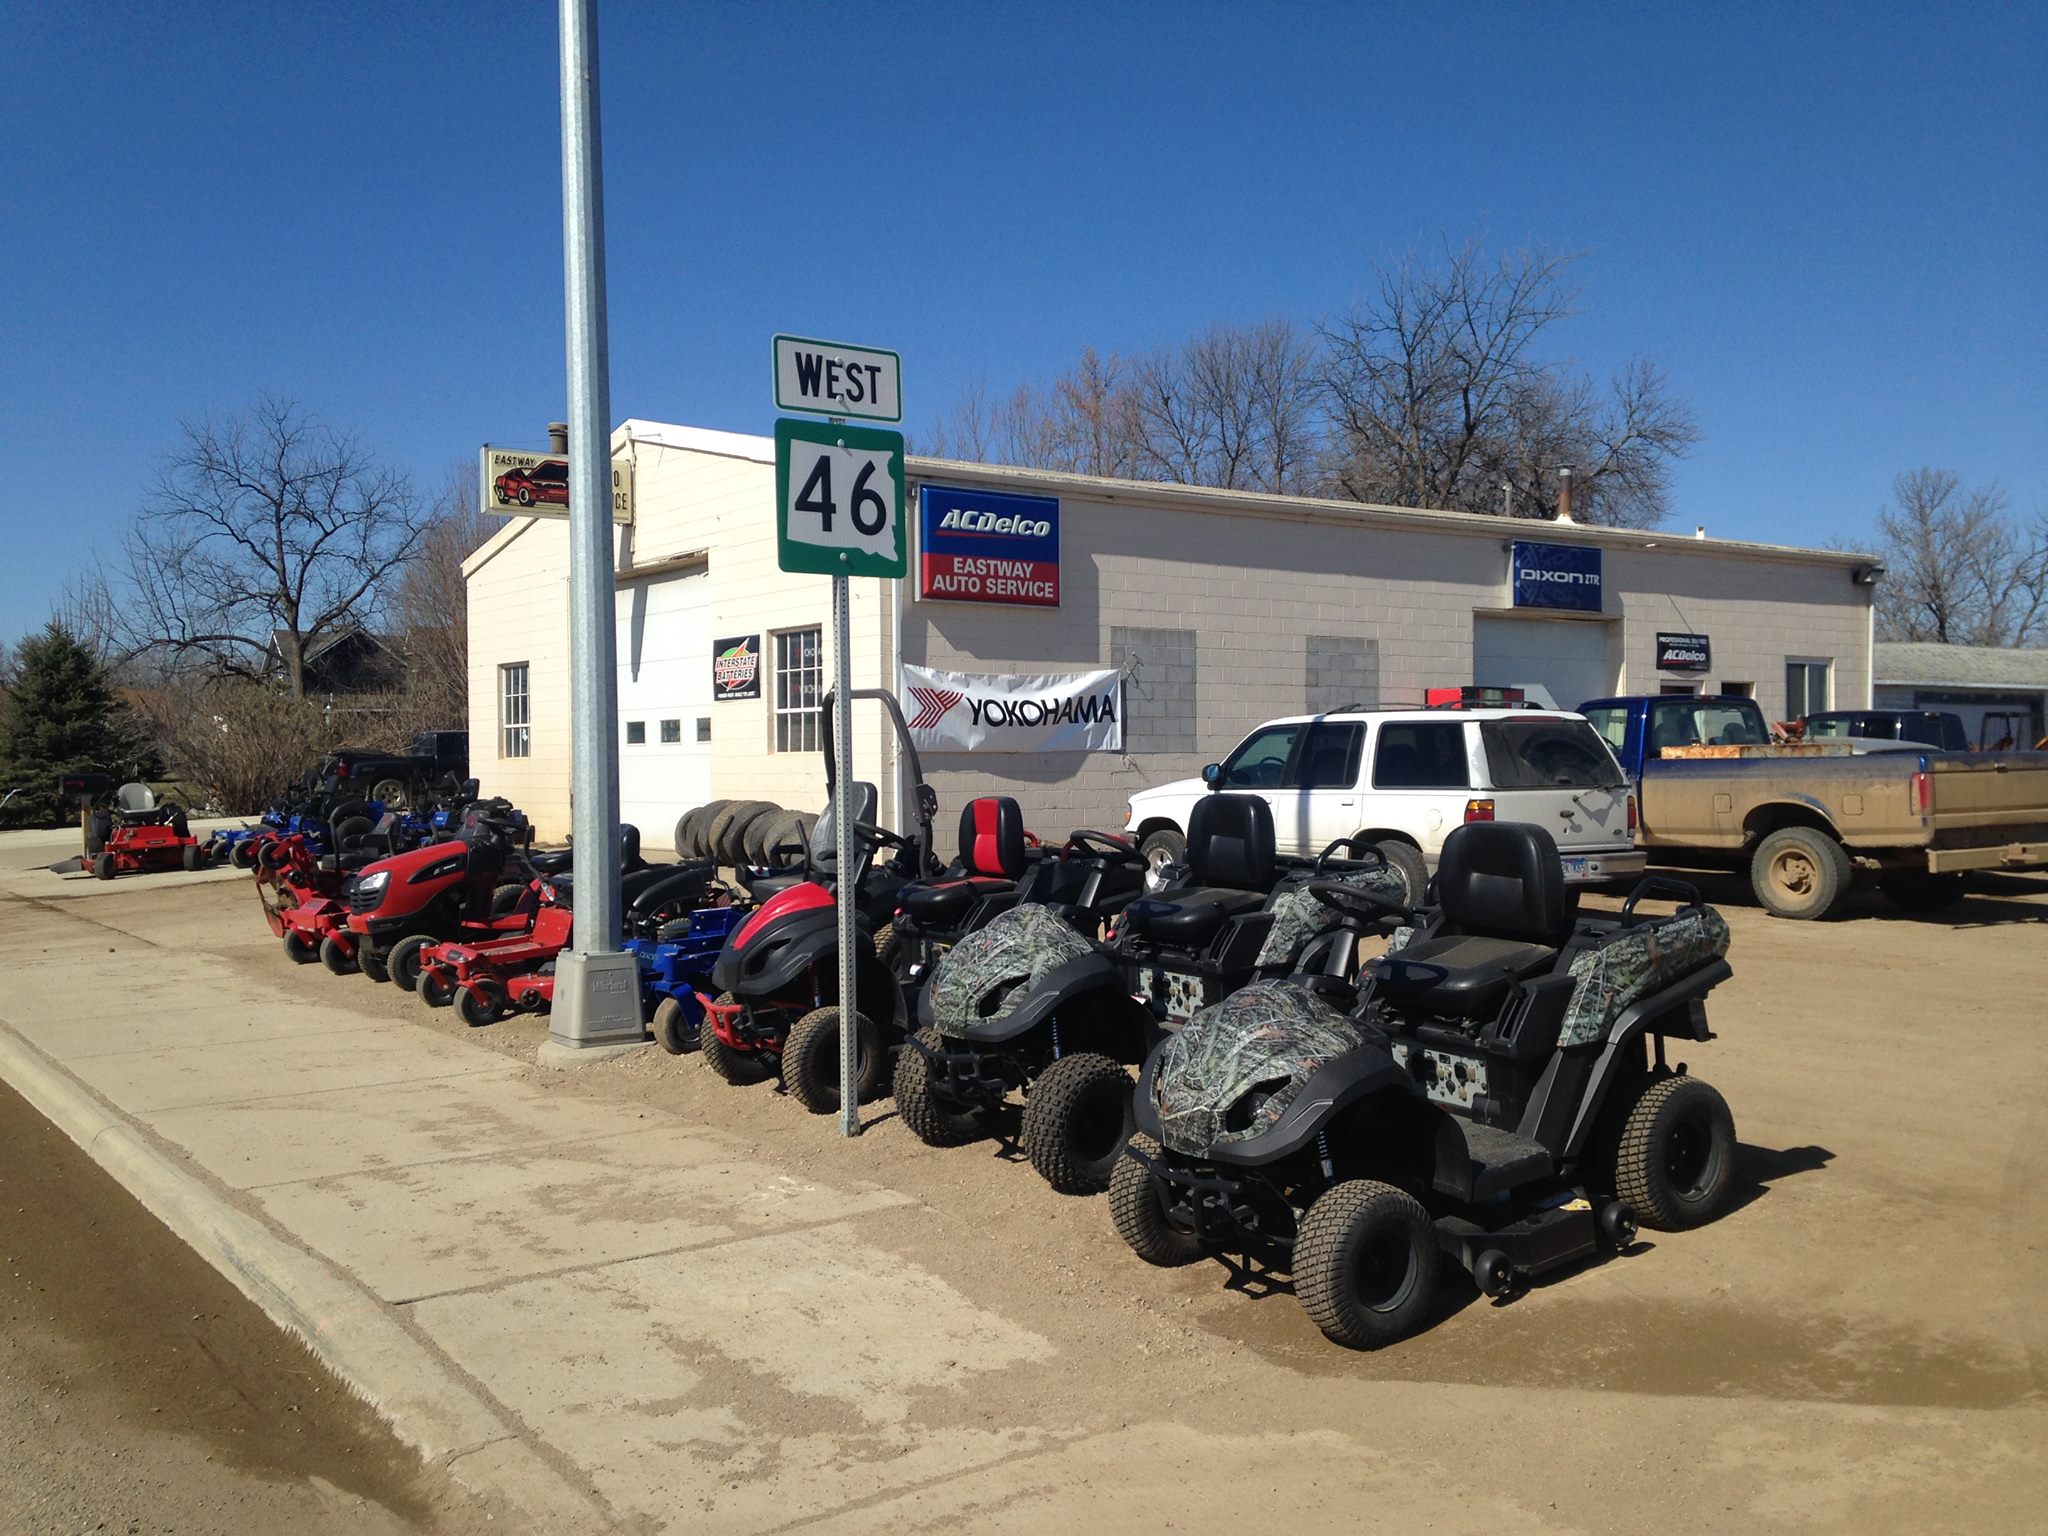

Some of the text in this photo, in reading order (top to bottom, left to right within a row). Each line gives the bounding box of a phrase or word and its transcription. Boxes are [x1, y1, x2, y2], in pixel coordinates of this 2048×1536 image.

[794, 351, 882, 404] WEST
[494, 454, 535, 467] EASTWAY
[794, 455, 887, 536] 46
[939, 509, 1051, 537] ACDelco
[953, 557, 1034, 579] EASTWAY
[1520, 569, 1584, 584] DIXON
[932, 575, 1054, 598] AUTO SERVICE
[716, 656, 756, 669] INTERSTATE
[1663, 649, 1707, 662] ACDelco
[717, 668, 753, 681] BATTERIES
[965, 694, 1117, 727] YOKOHAMA
